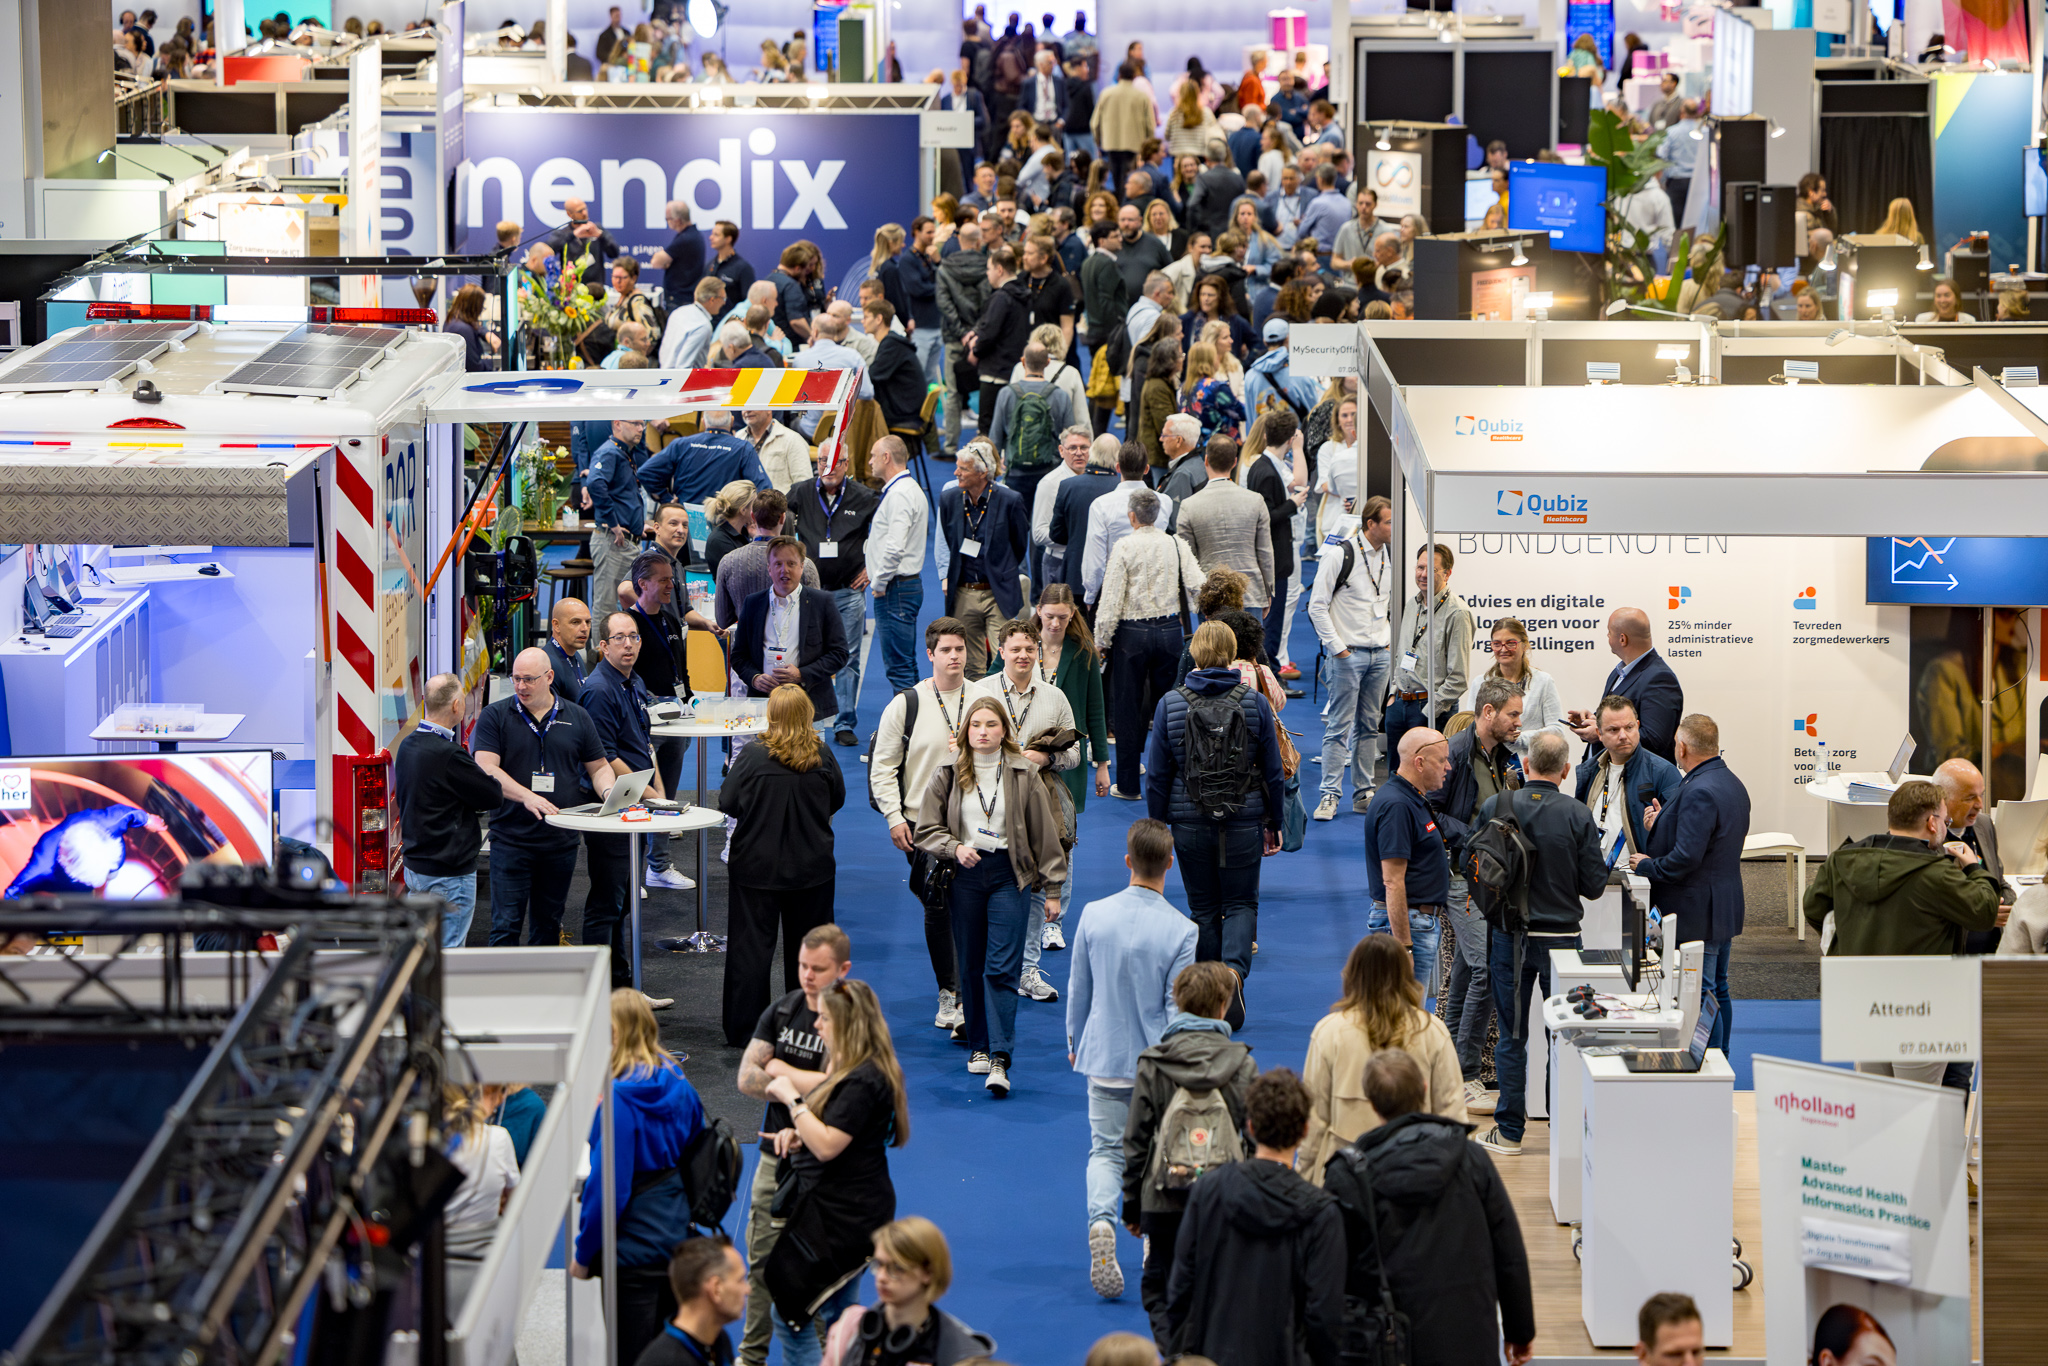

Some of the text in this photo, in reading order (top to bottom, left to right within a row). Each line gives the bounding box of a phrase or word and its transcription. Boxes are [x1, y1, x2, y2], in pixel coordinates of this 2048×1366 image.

[1477, 418, 1524, 435] Qubiz
[386, 441, 416, 561] POR
[1527, 494, 1588, 516] Qubiz
[1516, 598, 1537, 608] en
[1541, 594, 1605, 611] digitale
[1561, 619, 1601, 629] voor
[1667, 620, 1733, 630] 25% minder
[1793, 621, 1842, 631] Tevreden
[1667, 634, 1754, 645] administratieve
[1792, 635, 1890, 646] zorgmedewerkers
[1667, 648, 1702, 658] lasten
[1832, 750, 1857, 759] zorg
[1869, 1001, 1932, 1017] Attendi
[1899, 1042, 1968, 1055] 07.DATA01
[1774, 1092, 1856, 1119] inholland
[1801, 1156, 1847, 1176] Master
[1801, 1175, 1908, 1206] Advanced Health
[1802, 1193, 1931, 1231] Informatics Practice
